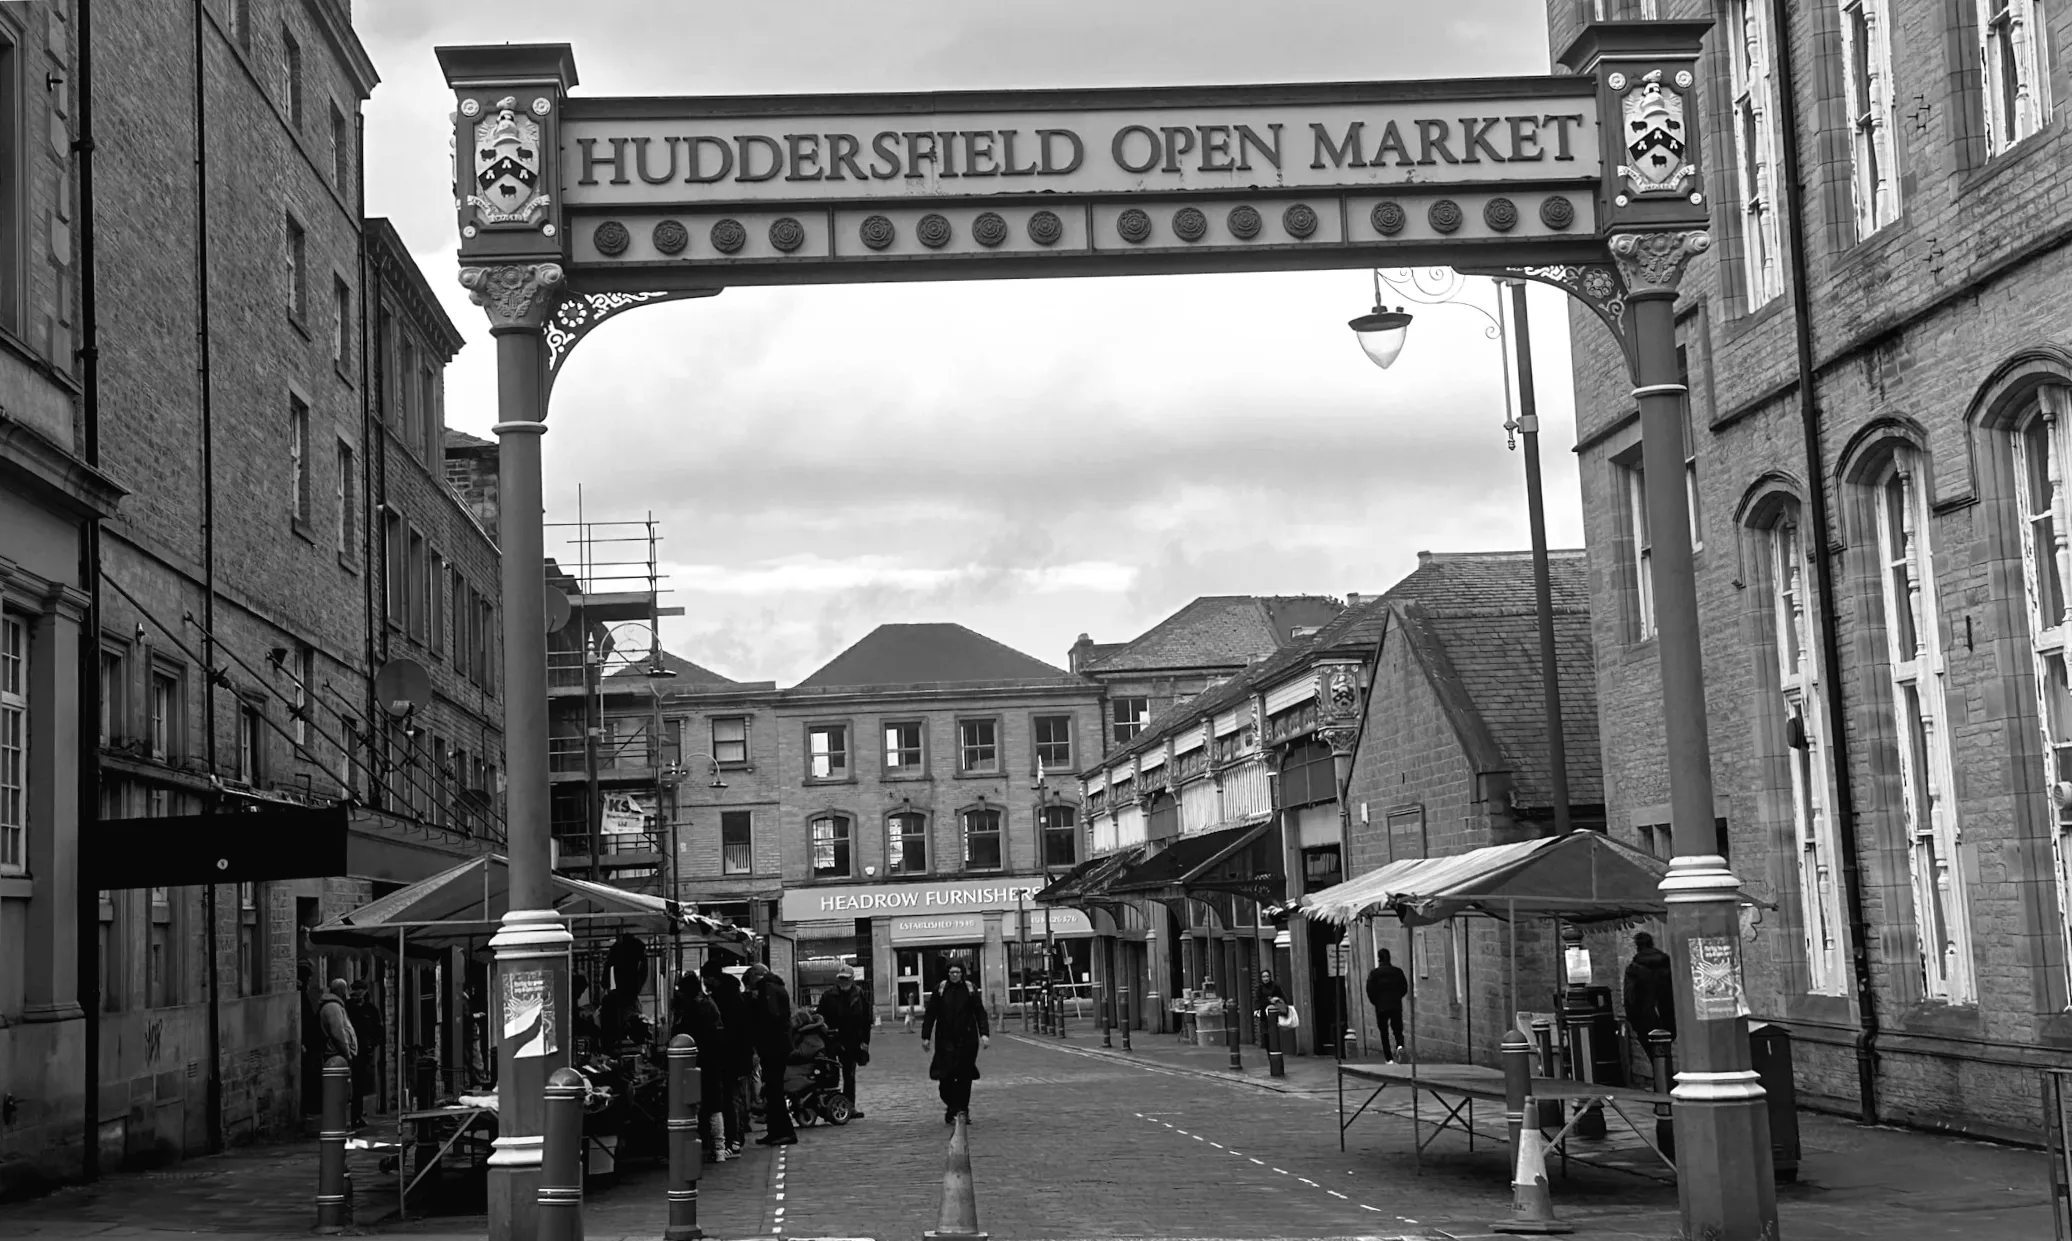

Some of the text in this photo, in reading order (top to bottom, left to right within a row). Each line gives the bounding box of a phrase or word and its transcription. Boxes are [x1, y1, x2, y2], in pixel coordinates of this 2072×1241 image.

[576, 113, 1583, 186] HUDDERSFIELD OPEN MARKET
[820, 890, 919, 911] HEADROW
[899, 919, 952, 930] ESTABLISHED
